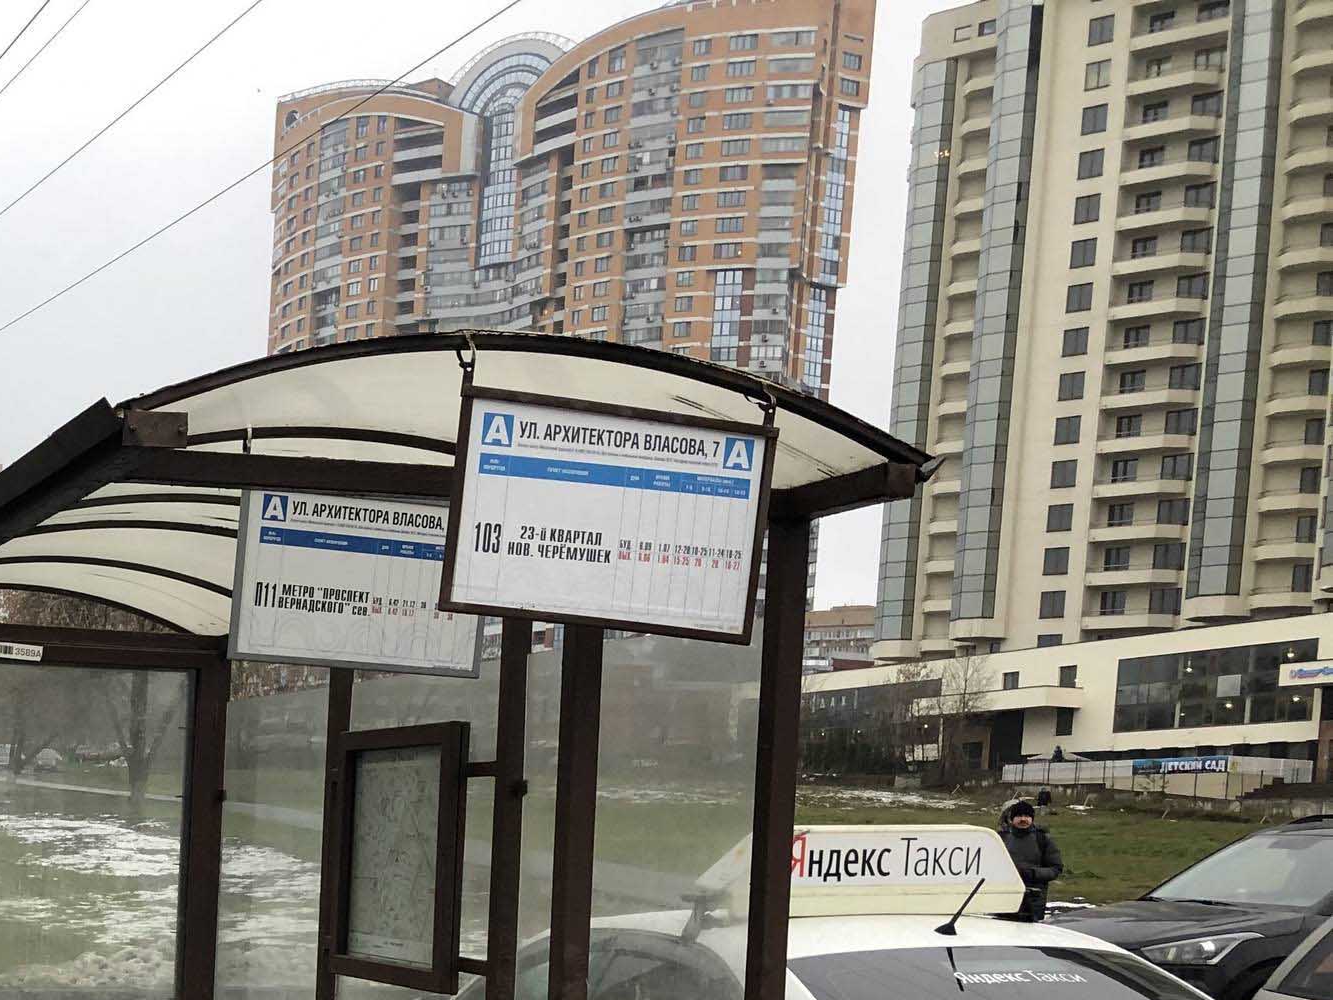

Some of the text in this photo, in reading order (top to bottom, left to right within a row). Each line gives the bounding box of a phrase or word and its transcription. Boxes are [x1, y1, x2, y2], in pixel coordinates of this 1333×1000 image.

[519, 421, 539, 439] УЛ.
[544, 424, 639, 449] АРХИТЕКТОРА
[643, 434, 708, 459] ВЛАСОВА,
[713, 441, 720, 457] 7
[292, 501, 308, 516] УЛ.
[312, 503, 389, 525] АРХИТЕКТОРА
[474, 522, 502, 553] 103
[520, 526, 602, 546] 23-й КВАРТАЛ
[507, 541, 611, 563] НОВ. ЧЕРЁМУШЕК
[254, 581, 277, 608] П11
[278, 596, 350, 613] ВЕРНАДСКОГО"
[281, 584, 370, 604] МЕТРО "ПРОСПЕКТ
[1205, 760, 1226, 772] САД
[791, 835, 982, 882] Яндекс Такси
